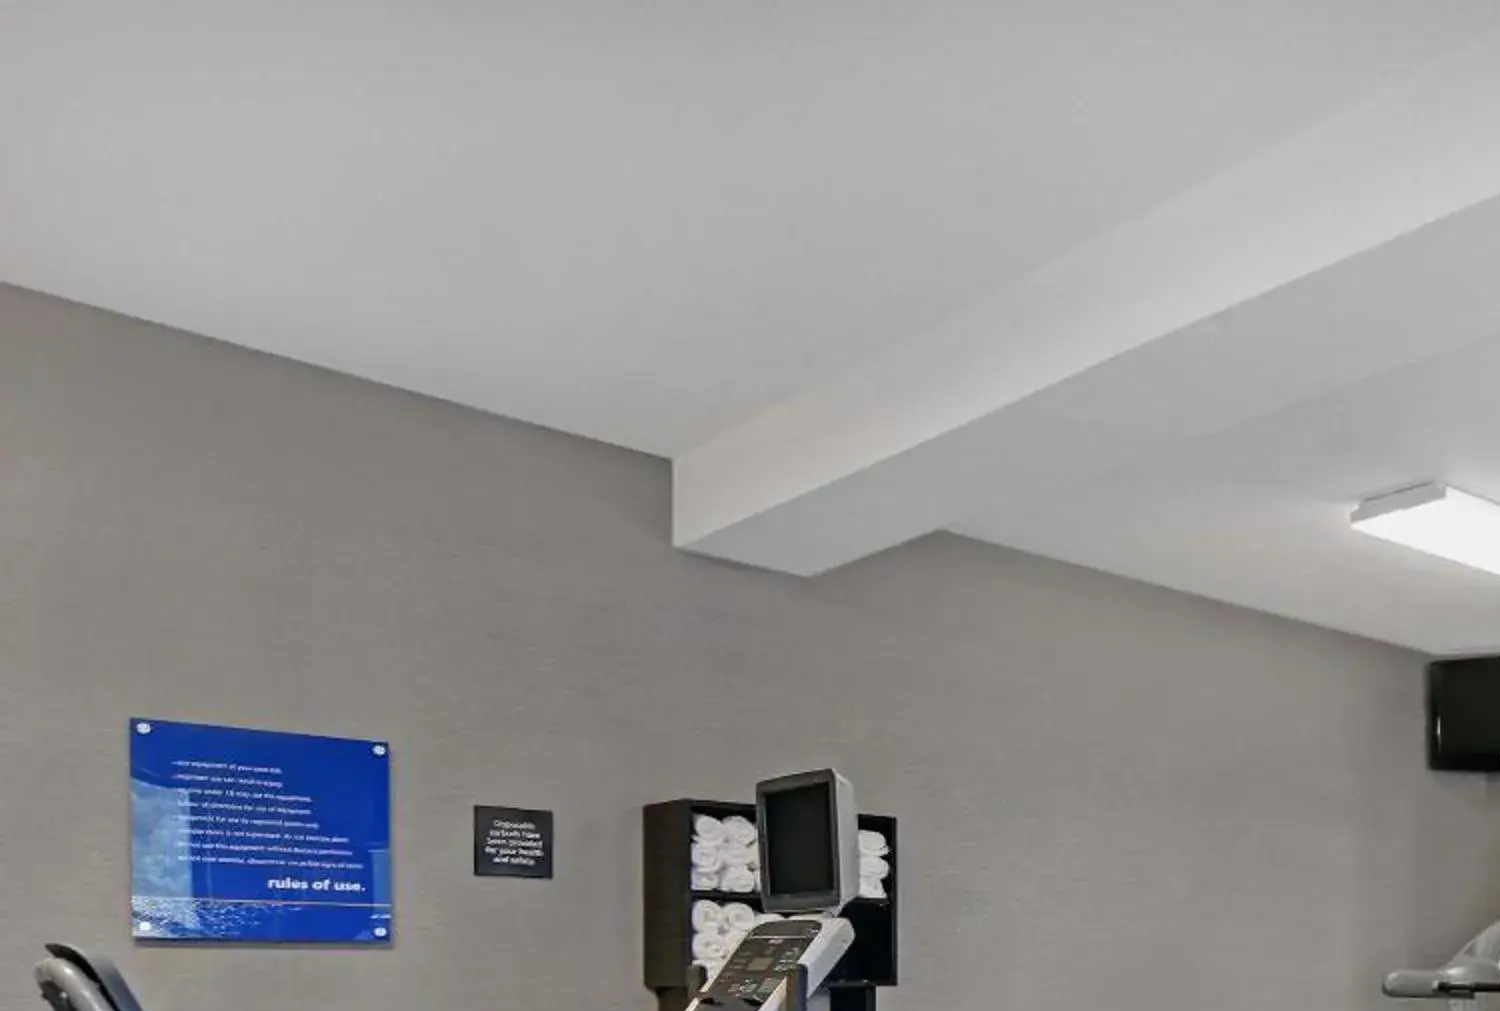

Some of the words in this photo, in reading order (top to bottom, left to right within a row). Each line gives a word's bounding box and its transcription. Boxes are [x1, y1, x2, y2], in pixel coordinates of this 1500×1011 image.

[267, 877, 308, 890] rules
[312, 878, 330, 891] of
[334, 882, 366, 892] use.
